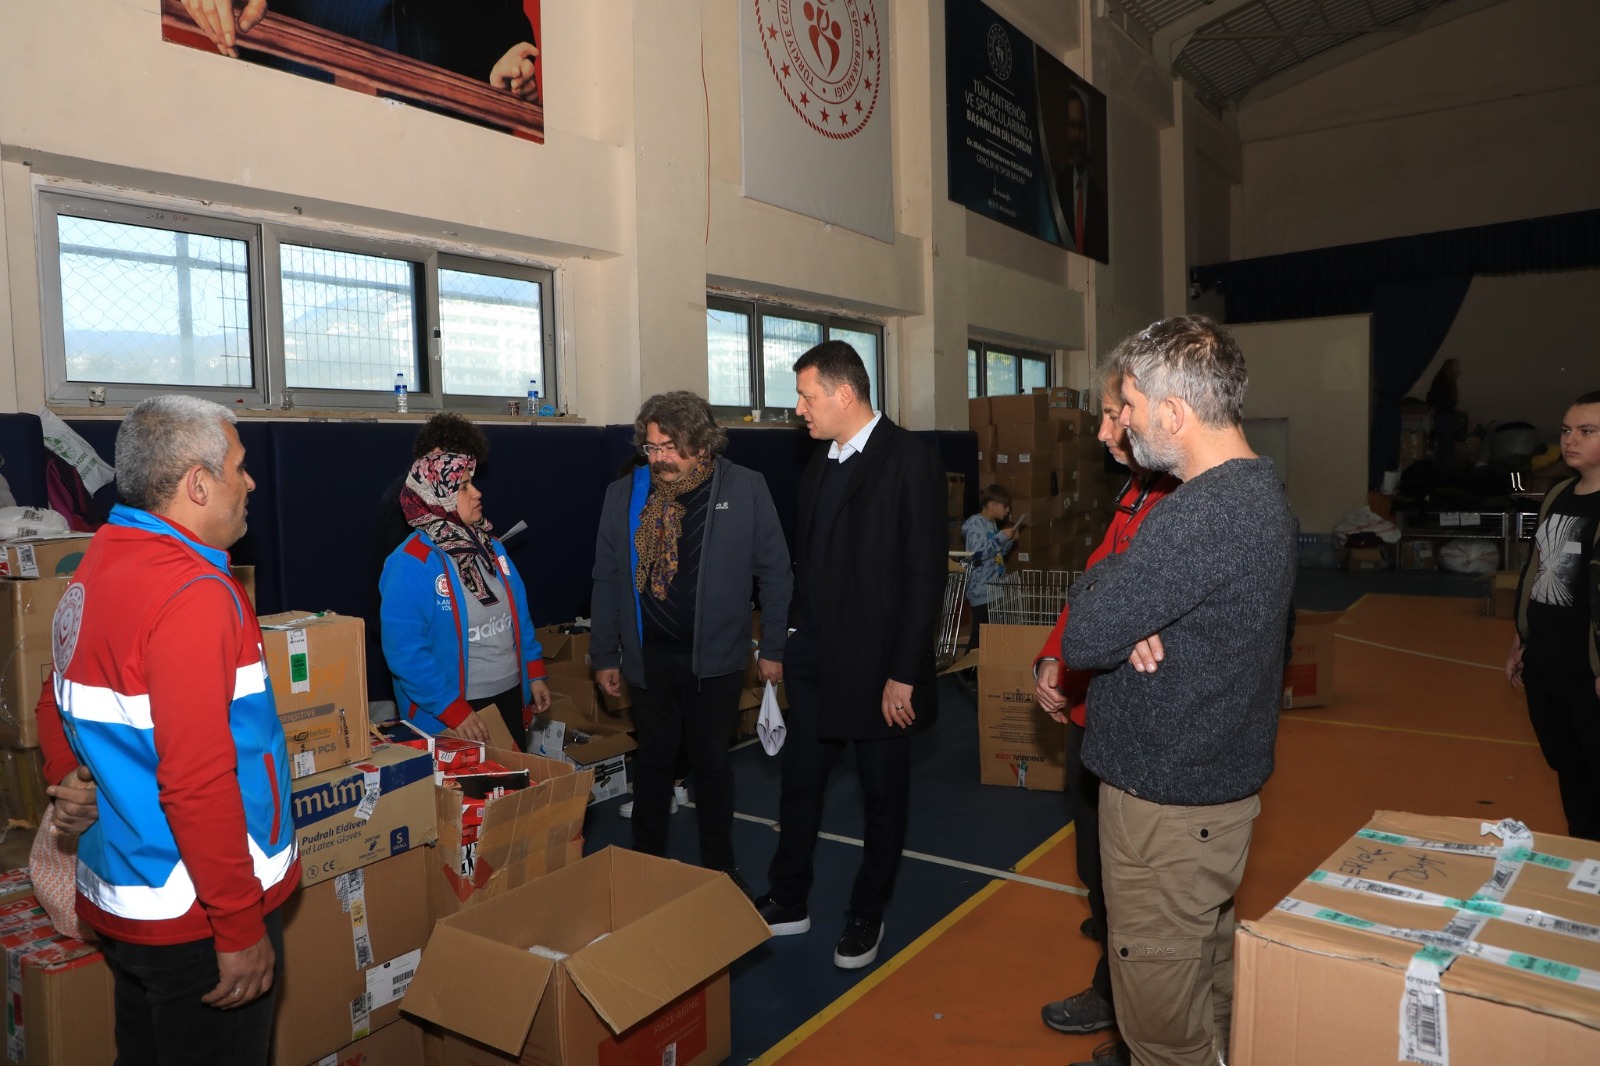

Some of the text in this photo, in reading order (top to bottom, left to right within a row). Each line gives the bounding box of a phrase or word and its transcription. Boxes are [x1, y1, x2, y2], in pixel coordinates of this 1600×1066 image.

[851, 11, 860, 47] SPOR
[781, 0, 814, 87] TÜRKİYE CU
[834, 50, 861, 99] BAKANLIĞI
[973, 79, 1026, 123] TÜM ANTRENÖR
[965, 90, 1033, 141] VE SPORCULARIMIZA
[967, 109, 1000, 137] BAŞARILAR
[318, 743, 337, 755] PCS
[302, 828, 335, 846] Pudralı
[335, 819, 367, 836] Eldiven
[313, 840, 334, 853] Latex
[336, 831, 362, 844] Gloves
[392, 842, 408, 850] SMALL
[396, 832, 403, 844] S
